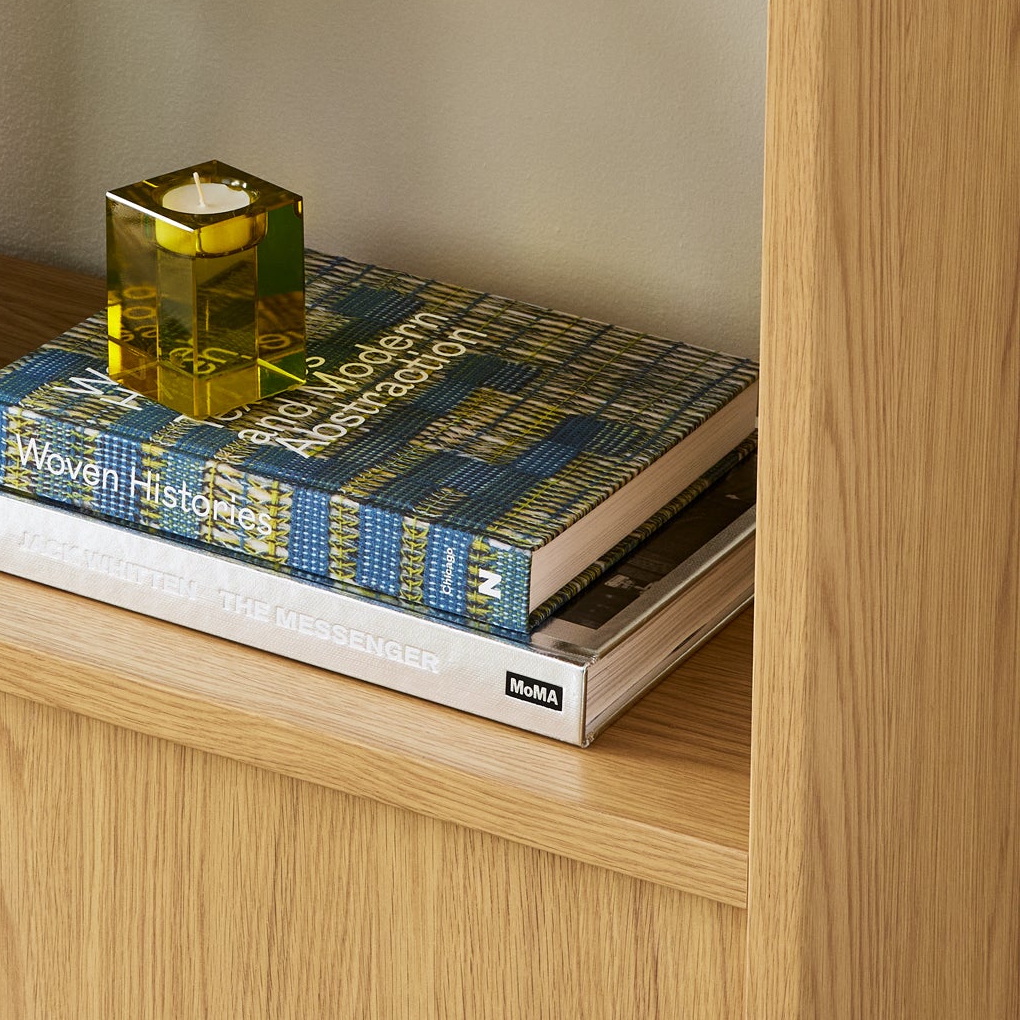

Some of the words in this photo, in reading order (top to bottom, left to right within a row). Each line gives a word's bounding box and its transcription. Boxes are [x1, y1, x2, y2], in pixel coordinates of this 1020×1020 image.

[238, 396, 318, 445] and
[296, 311, 450, 399] Modern
[275, 328, 488, 459] Abstraction
[14, 433, 121, 493] Woven
[129, 470, 275, 537] Histories
[20, 531, 82, 567] JACK
[83, 548, 197, 601] WHITTEN
[220, 588, 272, 623] THE
[275, 604, 440, 675] MESSENGER
[442, 547, 456, 595] Chicago
[509, 677, 559, 706] MoMA
